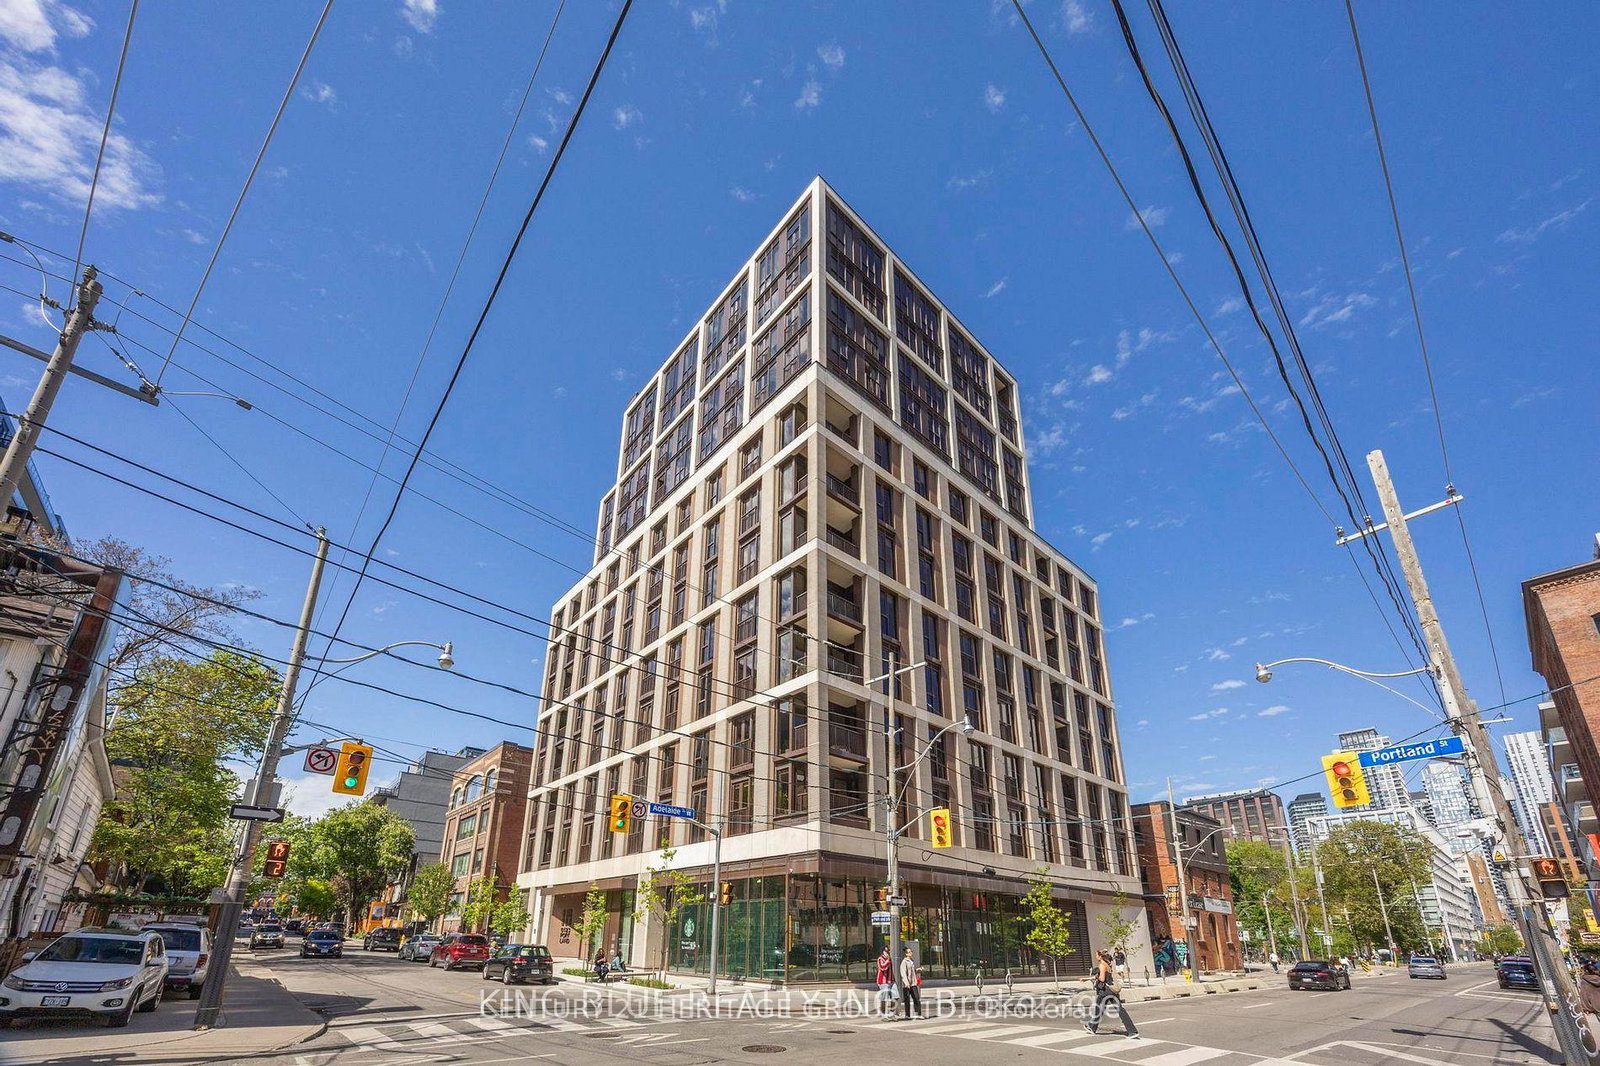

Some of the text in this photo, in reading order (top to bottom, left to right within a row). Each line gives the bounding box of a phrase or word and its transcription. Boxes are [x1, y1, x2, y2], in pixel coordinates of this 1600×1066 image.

[1371, 743, 1435, 763] Portland
[652, 805, 681, 815] Adelaide
[273, 862, 282, 875] 2
